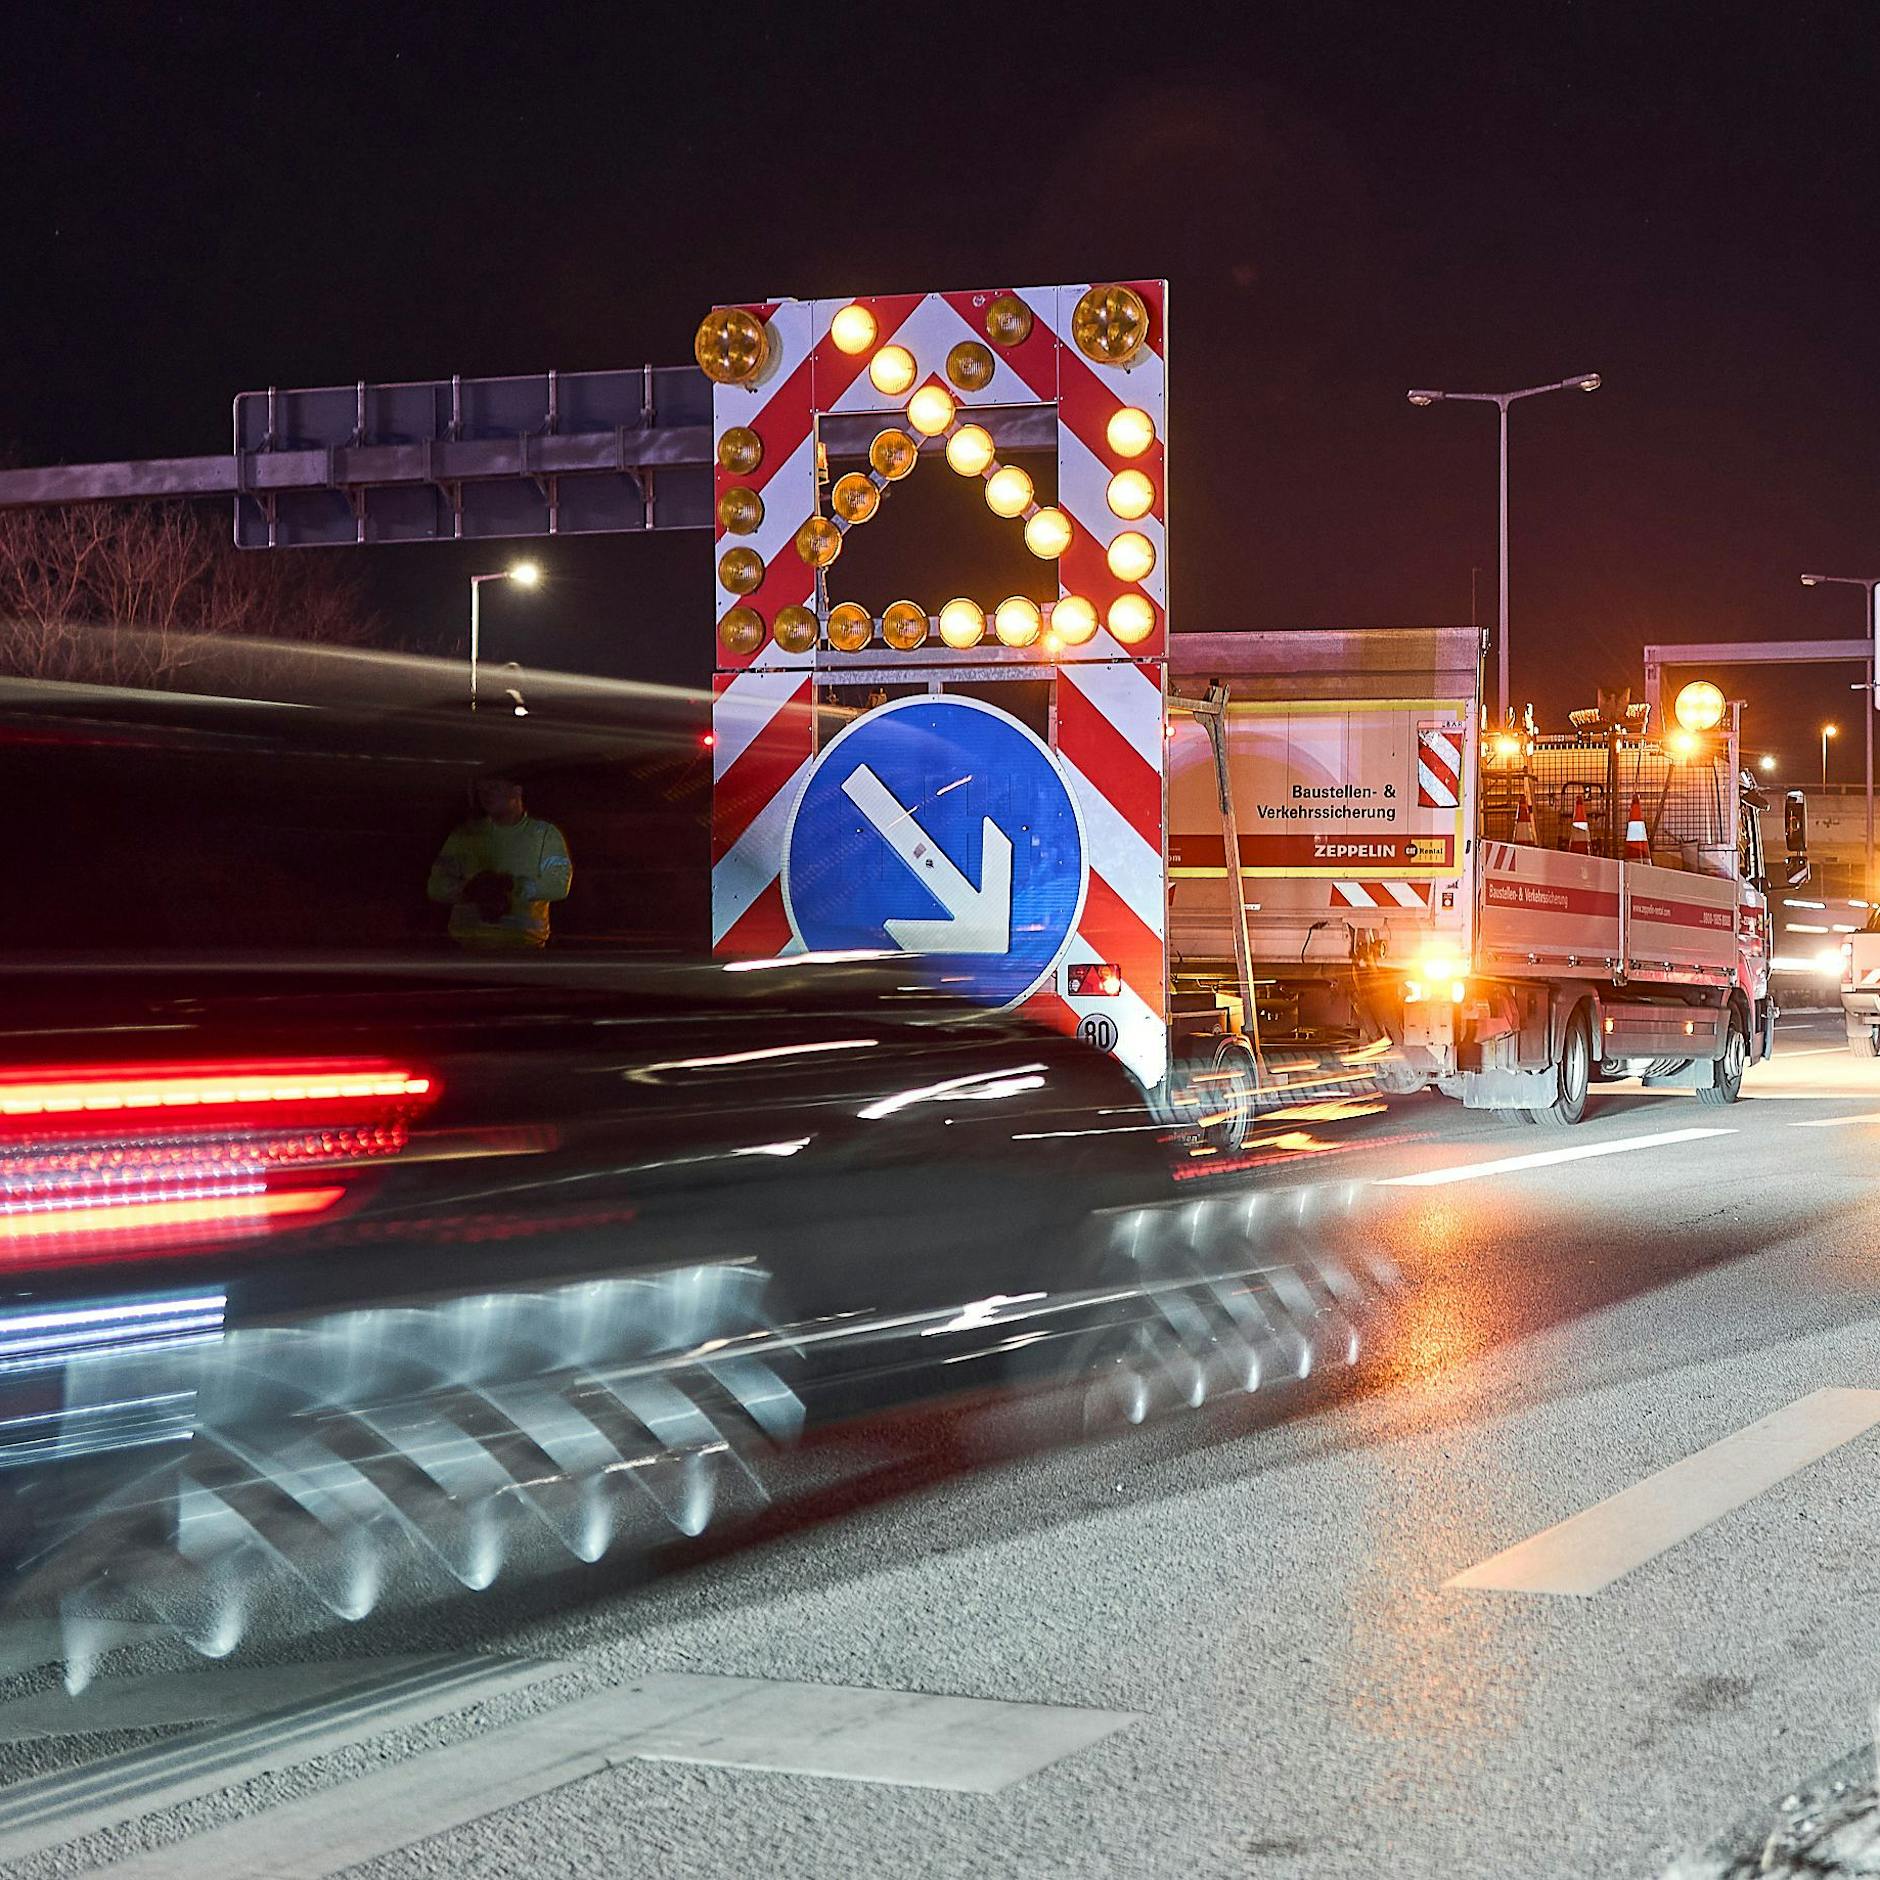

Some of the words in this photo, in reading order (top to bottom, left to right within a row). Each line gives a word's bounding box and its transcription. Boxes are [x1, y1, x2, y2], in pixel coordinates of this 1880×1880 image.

[1292, 784, 1377, 799] Baustellen-
[1383, 784, 1396, 799] &
[1257, 805, 1396, 822] Verkehrssicherung
[1314, 844, 1396, 858] ZEPPELIN
[1084, 1020, 1110, 1049] 80
